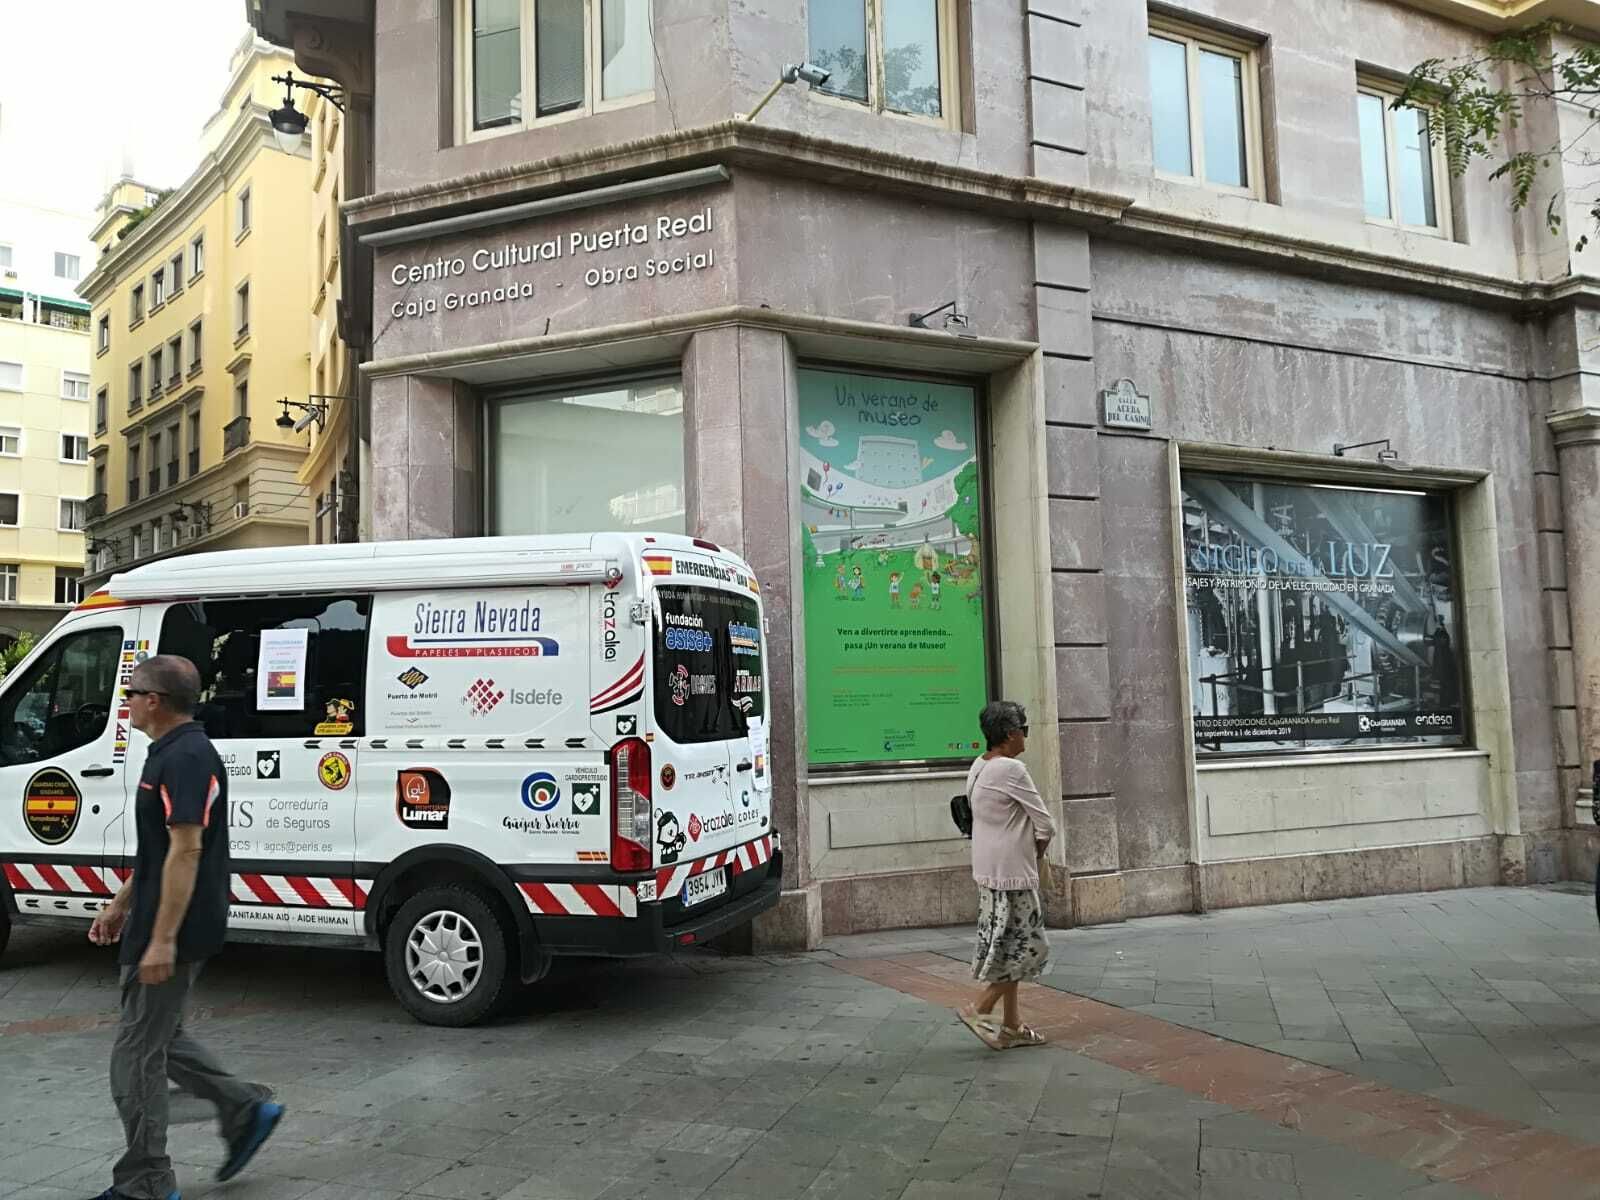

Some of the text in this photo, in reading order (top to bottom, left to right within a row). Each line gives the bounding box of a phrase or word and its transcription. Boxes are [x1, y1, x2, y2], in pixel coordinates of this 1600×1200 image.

[391, 207, 714, 286] Centro Cultural Puerta Real
[391, 298, 437, 320] Caja
[444, 281, 534, 310] Granada
[584, 265, 638, 289] Obra
[645, 248, 715, 278] Social
[835, 383, 939, 413] Un verano de
[858, 410, 922, 427] museo
[1327, 541, 1395, 578] LUZ
[676, 559, 732, 582] EMERGENCIAS
[1216, 578, 1267, 590] PATRIMONIO
[1268, 580, 1280, 590] DE
[1281, 581, 1291, 590] LA
[1292, 582, 1346, 593] ELECTRICIDAD
[1347, 584, 1358, 592] EN
[1359, 584, 1396, 594] GRANADA
[414, 599, 541, 634] Sierra Nevada
[665, 612, 704, 628] fundación
[837, 628, 853, 637] Ven
[861, 627, 898, 637] divertirte
[415, 646, 538, 657] PAPELES Y PLASTICOS
[844, 643, 862, 651] pasa
[880, 642, 907, 650] verano
[908, 641, 918, 650] de
[919, 641, 947, 650] Museo!
[509, 688, 563, 706] Isdefe
[1213, 719, 1222, 727] DE
[1222, 717, 1268, 727] EXPOSICIONES
[1415, 713, 1453, 726] endesa
[1195, 729, 1203, 738] de
[1204, 728, 1234, 739] septiembre
[1244, 728, 1252, 736] de
[1252, 727, 1278, 736] diciembre
[1278, 727, 1292, 736] 2019
[222, 754, 236, 764] ULO
[226, 766, 252, 776] TEGIDO
[268, 798, 329, 811] Correduría
[228, 800, 255, 829] IS
[402, 806, 446, 822] Lumar
[266, 816, 331, 832] de Seguros
[229, 840, 333, 854] GCS agcs@peris.es
[688, 874, 709, 897] 3954
[228, 911, 274, 922] MANITARIAN
[276, 911, 290, 921] AID
[297, 913, 316, 924] AIDE
[317, 914, 348, 926] HUMAN
